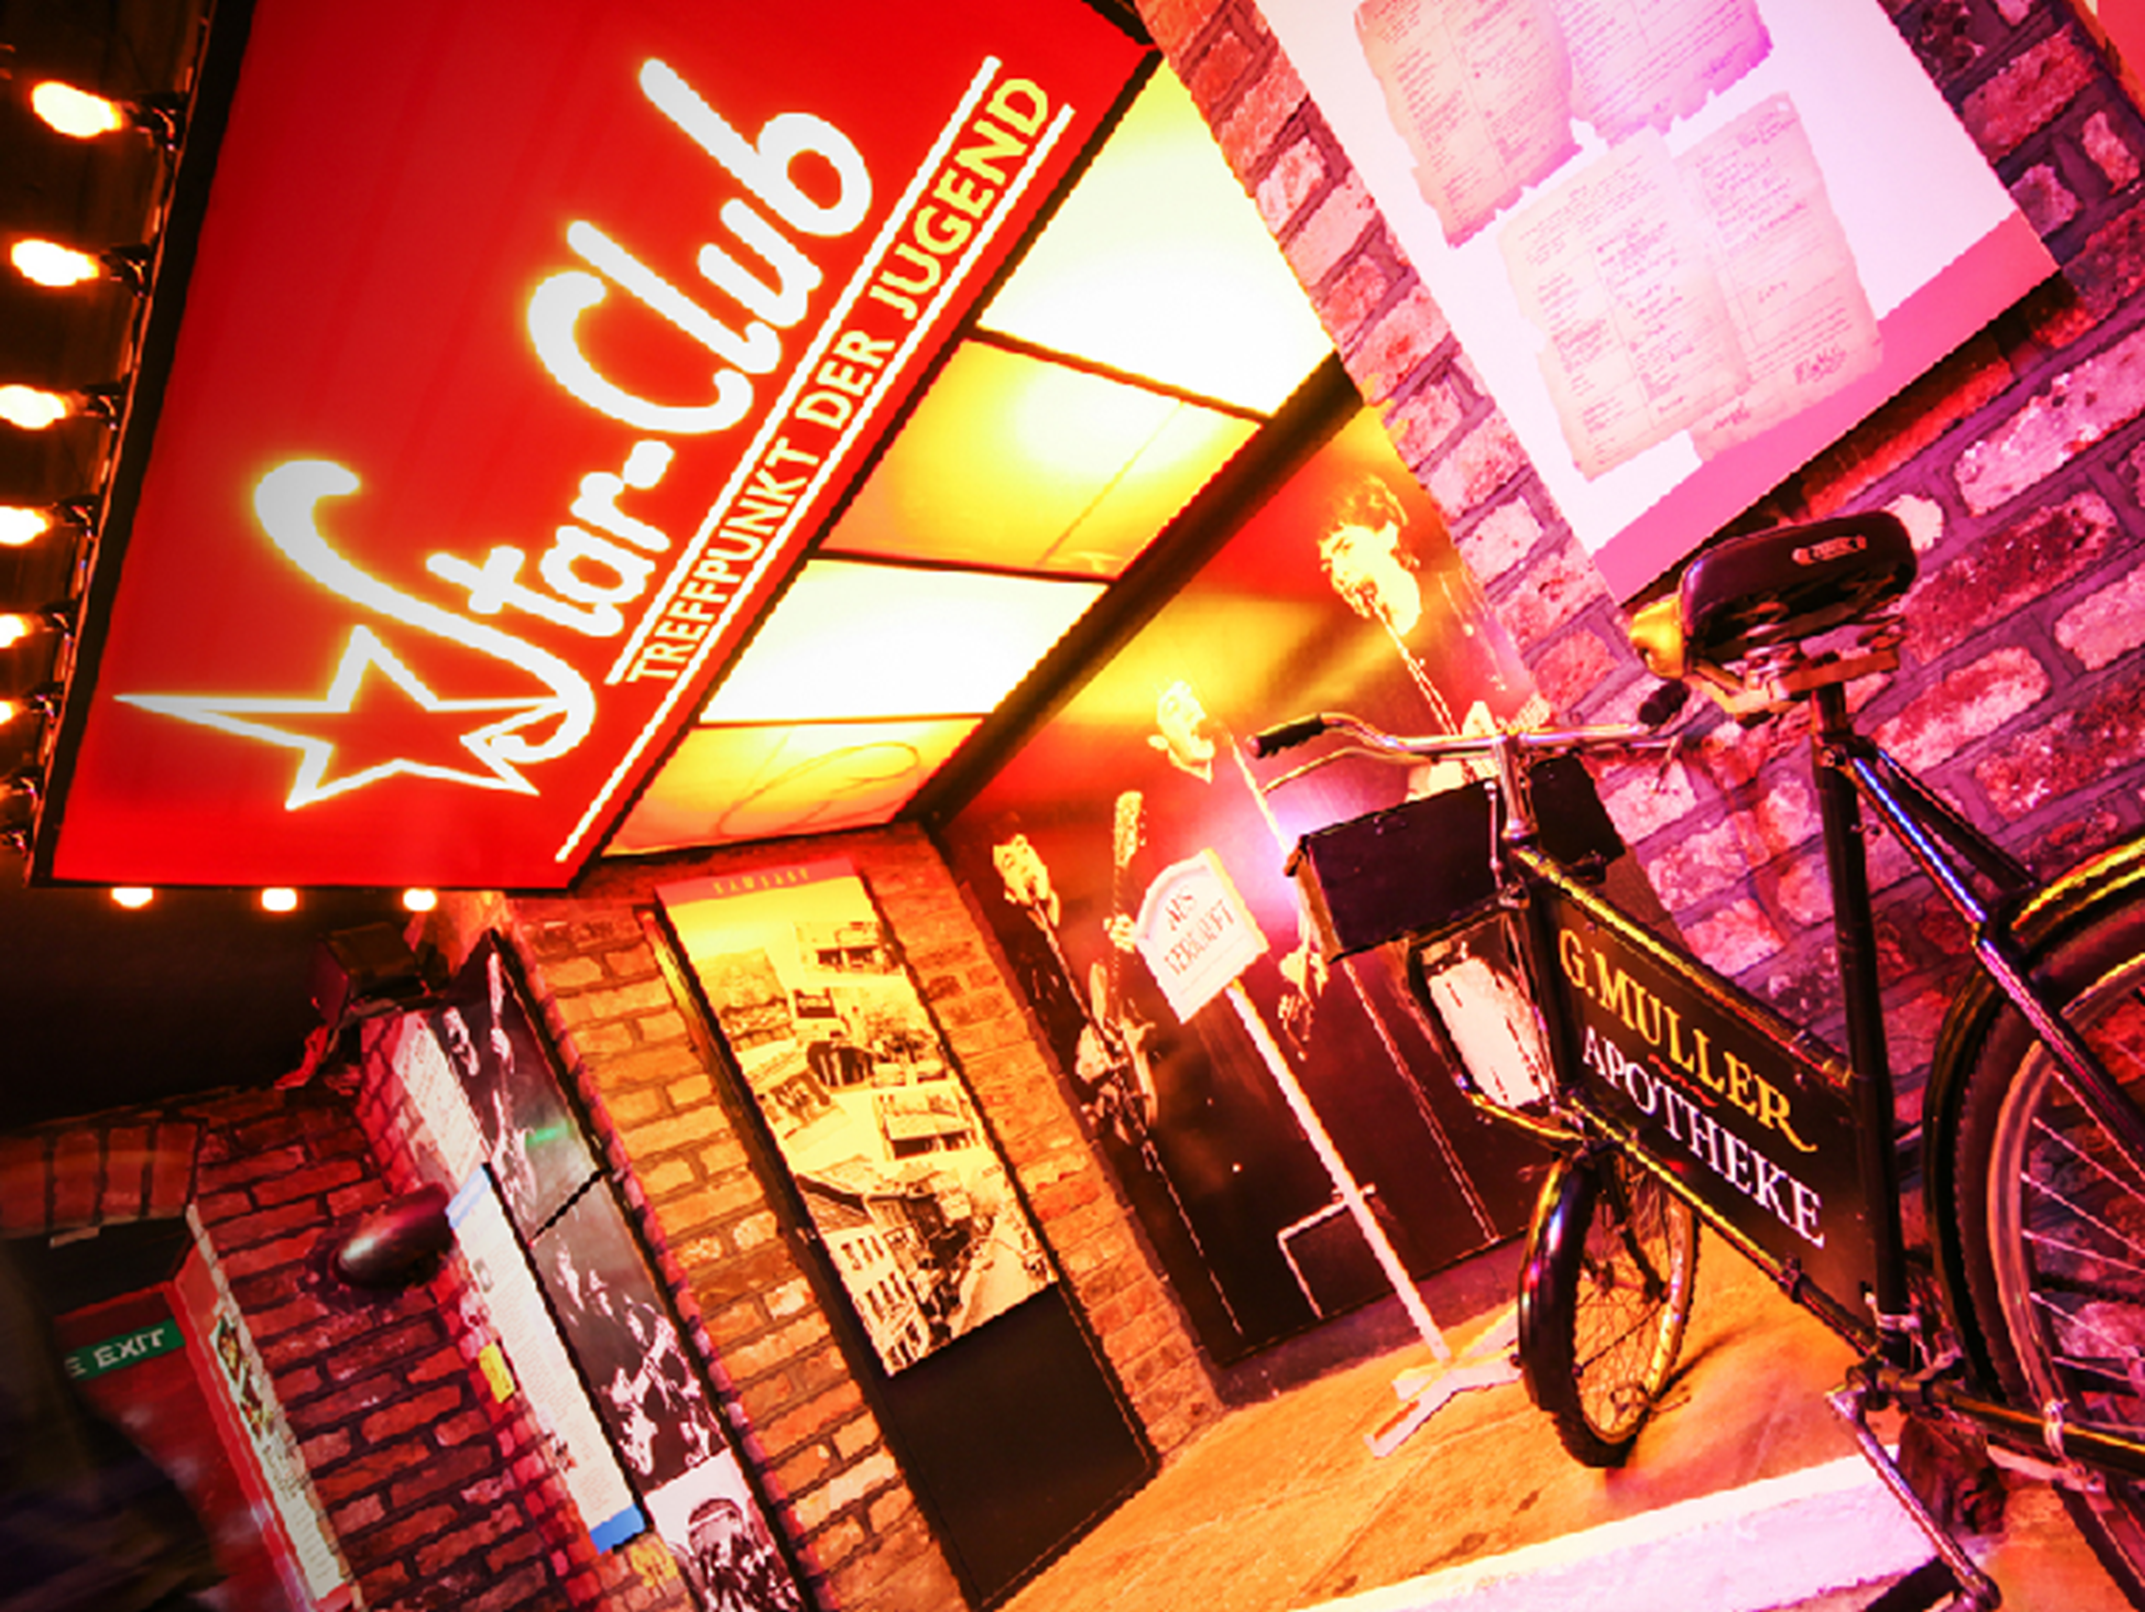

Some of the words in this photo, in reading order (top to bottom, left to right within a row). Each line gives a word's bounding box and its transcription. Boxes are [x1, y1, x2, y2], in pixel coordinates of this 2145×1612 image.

[254, 57, 873, 764] Star-Club
[625, 436, 820, 685] TREFFPUNKT
[794, 328, 896, 429] DER
[868, 77, 1050, 320] JUGEND
[1582, 1025, 1826, 1249] APOTHEKE
[92, 1327, 165, 1369] EXIT
